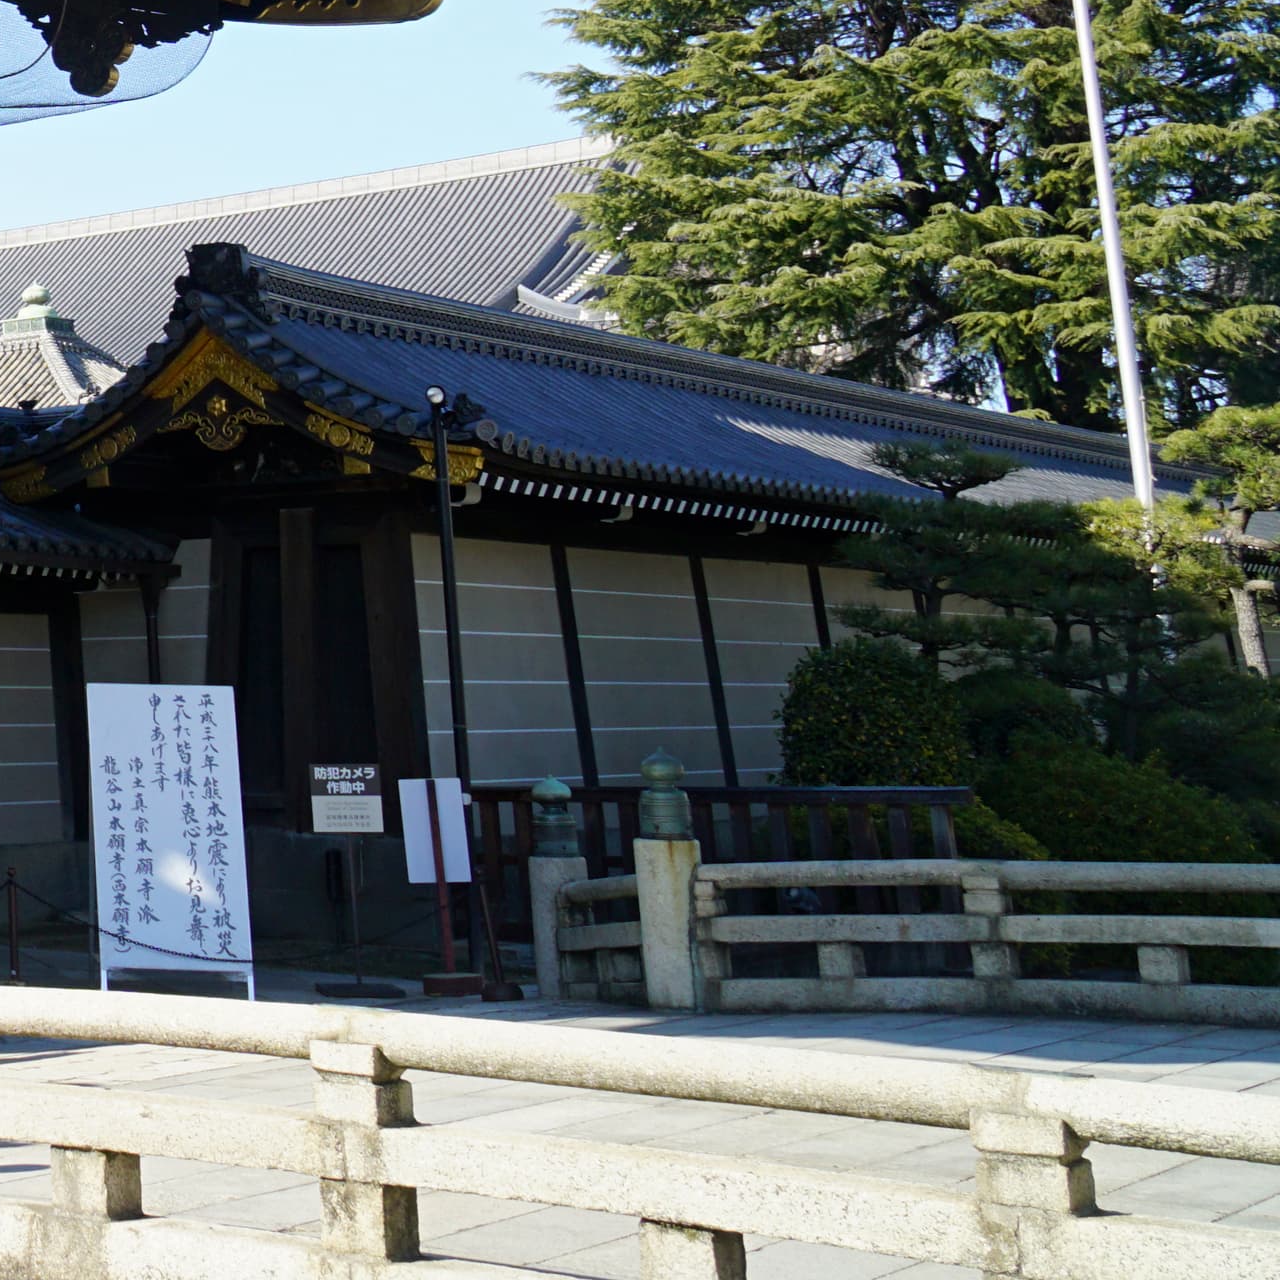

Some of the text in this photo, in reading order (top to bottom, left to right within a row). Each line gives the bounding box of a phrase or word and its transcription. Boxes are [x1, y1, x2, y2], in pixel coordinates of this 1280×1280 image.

[148, 693, 171, 792] 申しあげます
[313, 766, 376, 780] 防犯カメラ
[326, 781, 366, 795] 作動中
[128, 756, 161, 925] 浄土真宗本願寺派
